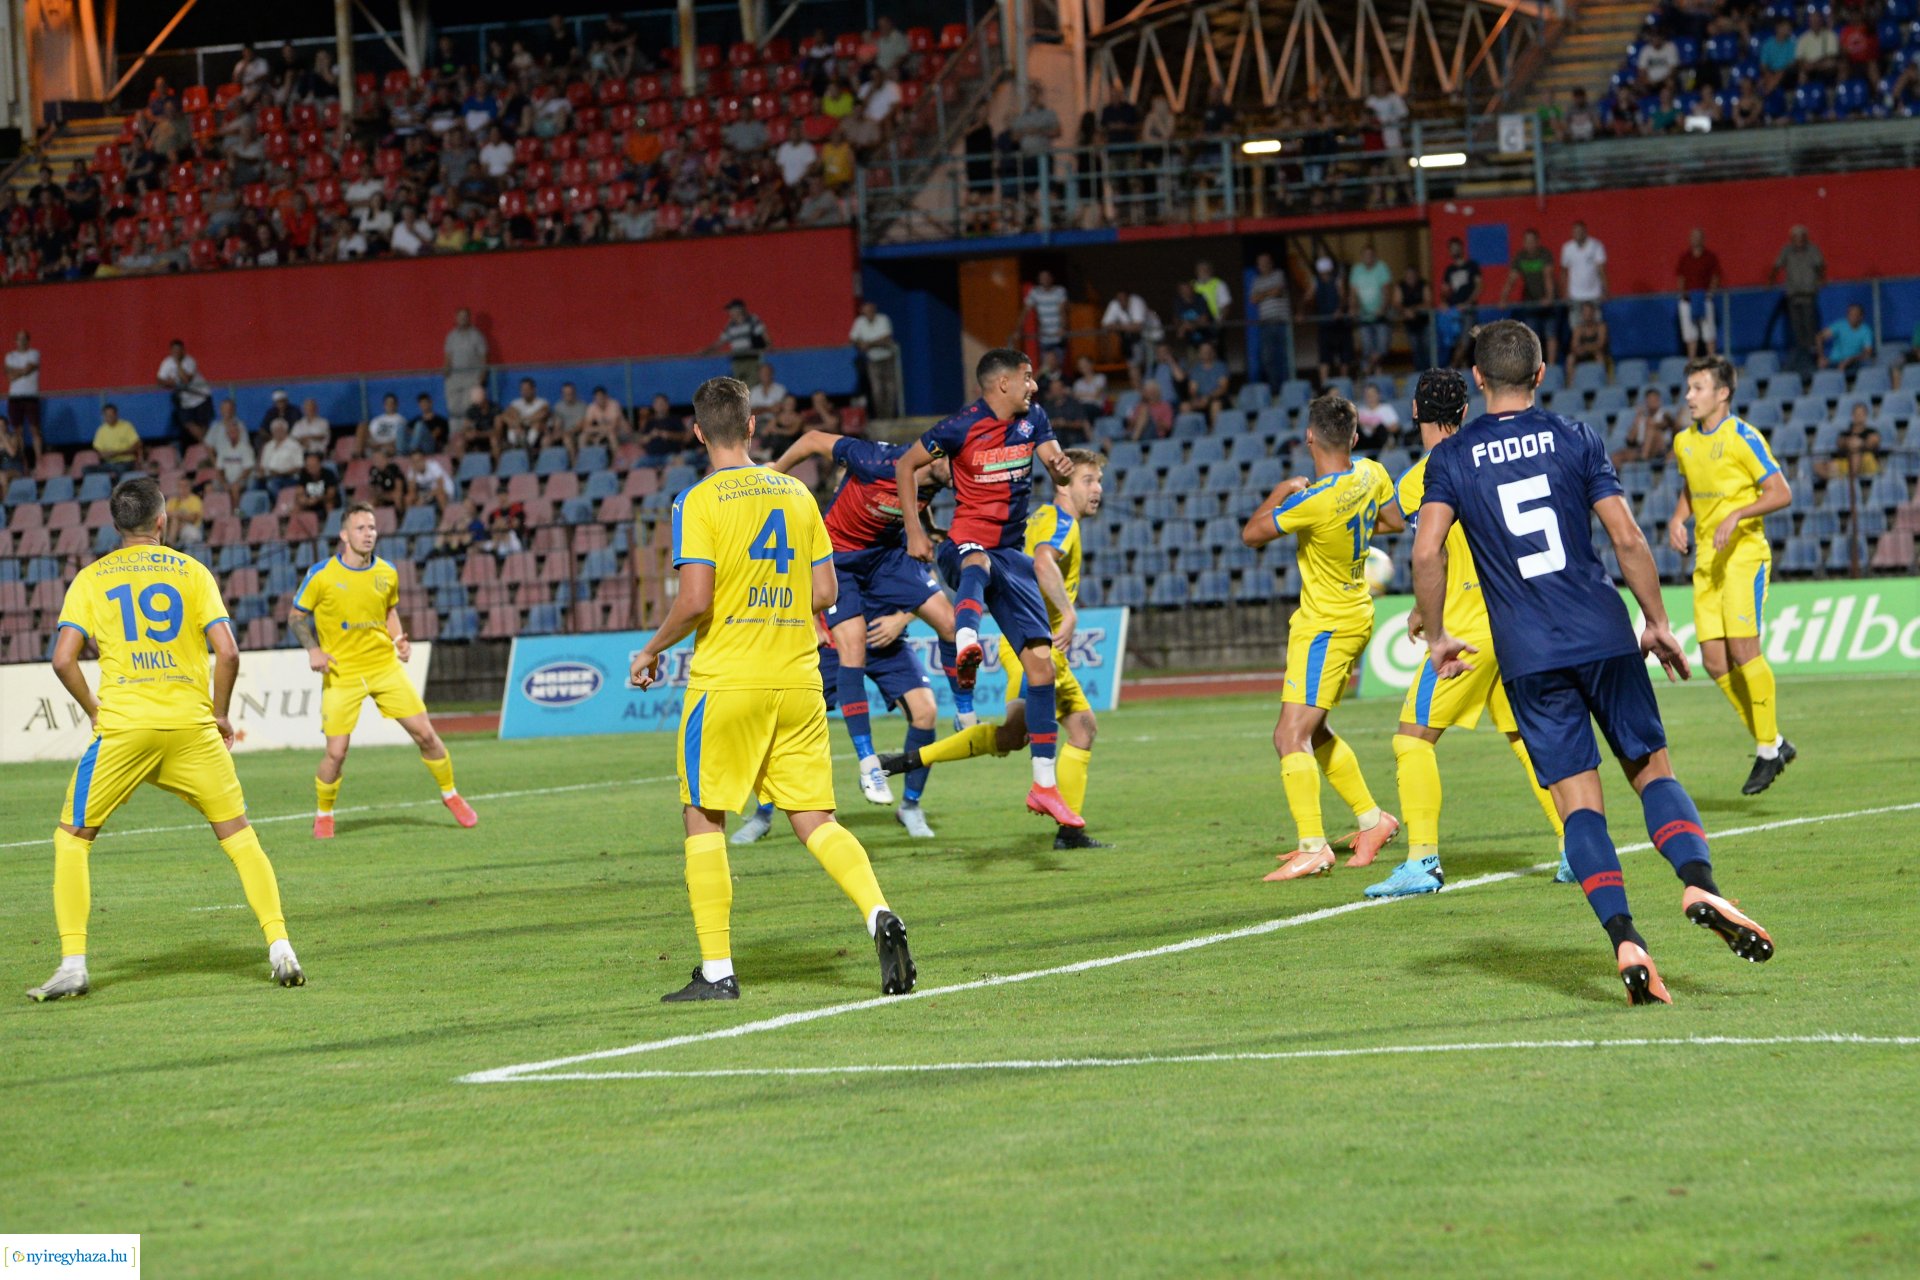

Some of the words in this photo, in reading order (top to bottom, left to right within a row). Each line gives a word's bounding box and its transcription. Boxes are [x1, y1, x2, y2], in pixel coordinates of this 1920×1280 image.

[1471, 431, 1555, 468] FODOR
[717, 487, 793, 503] KAZINCBARCIKA
[747, 508, 795, 574] 4
[1346, 499, 1376, 562] 18
[1496, 473, 1567, 580] 5
[95, 564, 177, 577] KAZINCBARCIKA
[104, 582, 184, 643] 19
[747, 583, 793, 609] DÁVID
